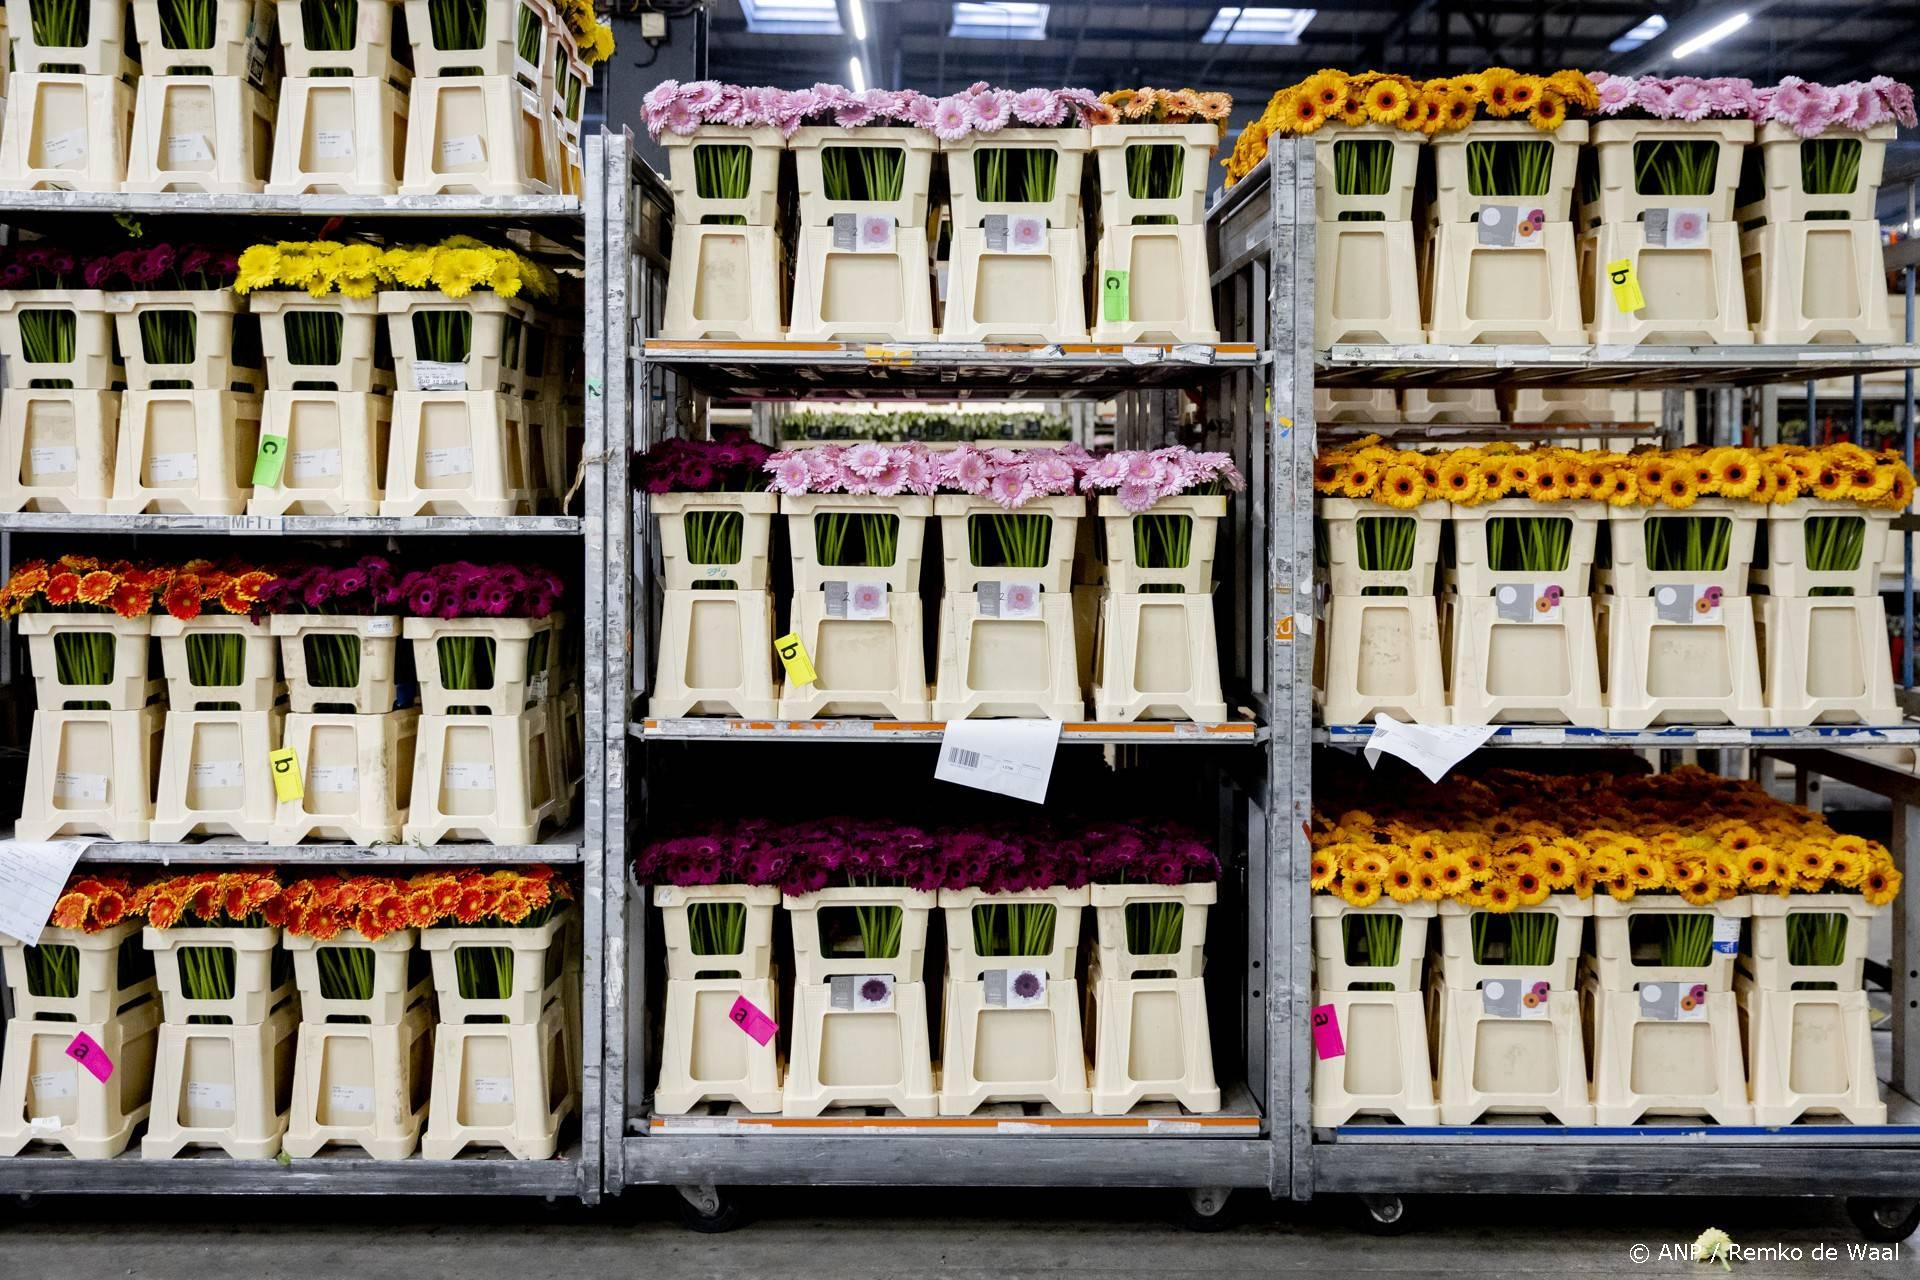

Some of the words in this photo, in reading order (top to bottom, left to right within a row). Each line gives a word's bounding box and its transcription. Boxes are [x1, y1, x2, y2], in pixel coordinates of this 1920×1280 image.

[1611, 268, 1629, 285] b
[780, 642, 799, 660] b
[274, 757, 294, 774] b
[734, 1007, 748, 1024] a
[1313, 1013, 1329, 1027] a
[73, 1043, 90, 1060] a
